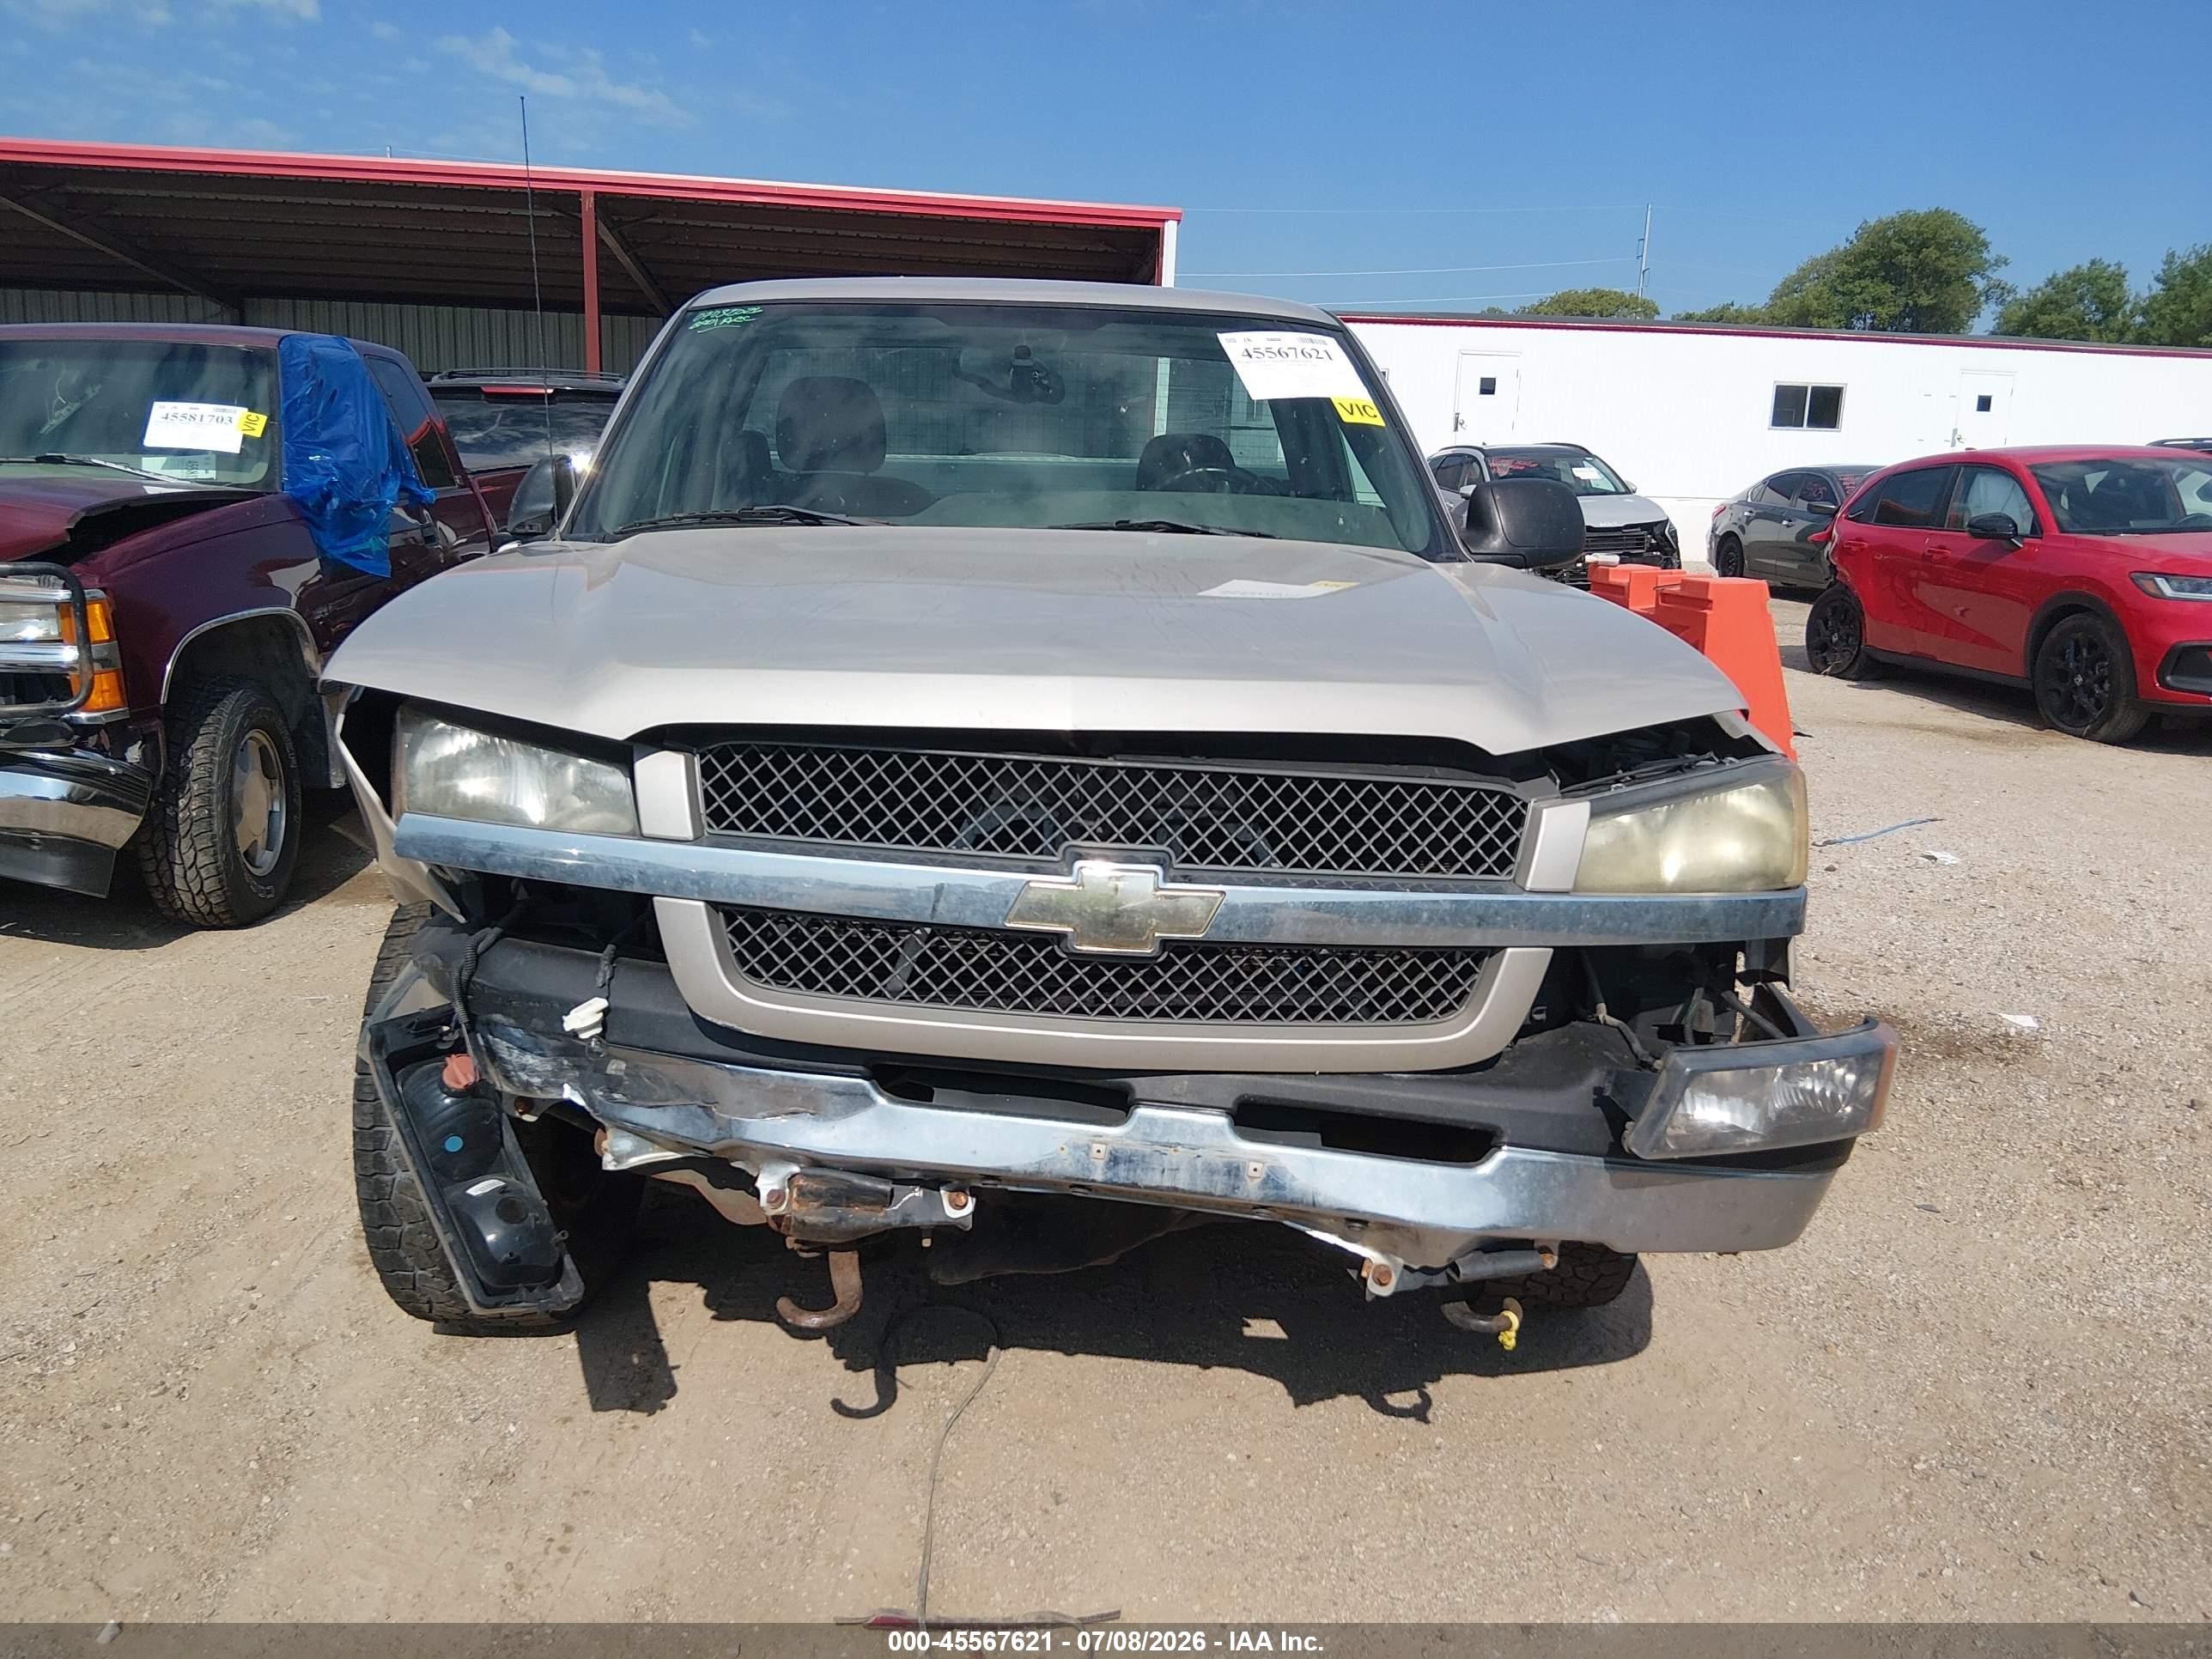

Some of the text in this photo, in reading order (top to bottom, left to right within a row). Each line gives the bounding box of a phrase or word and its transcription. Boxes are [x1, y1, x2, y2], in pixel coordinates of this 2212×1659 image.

[1241, 346, 1334, 361] 45567621
[1338, 401, 1378, 418] VIC
[160, 412, 234, 425] 45581703
[241, 414, 260, 431] VIC
